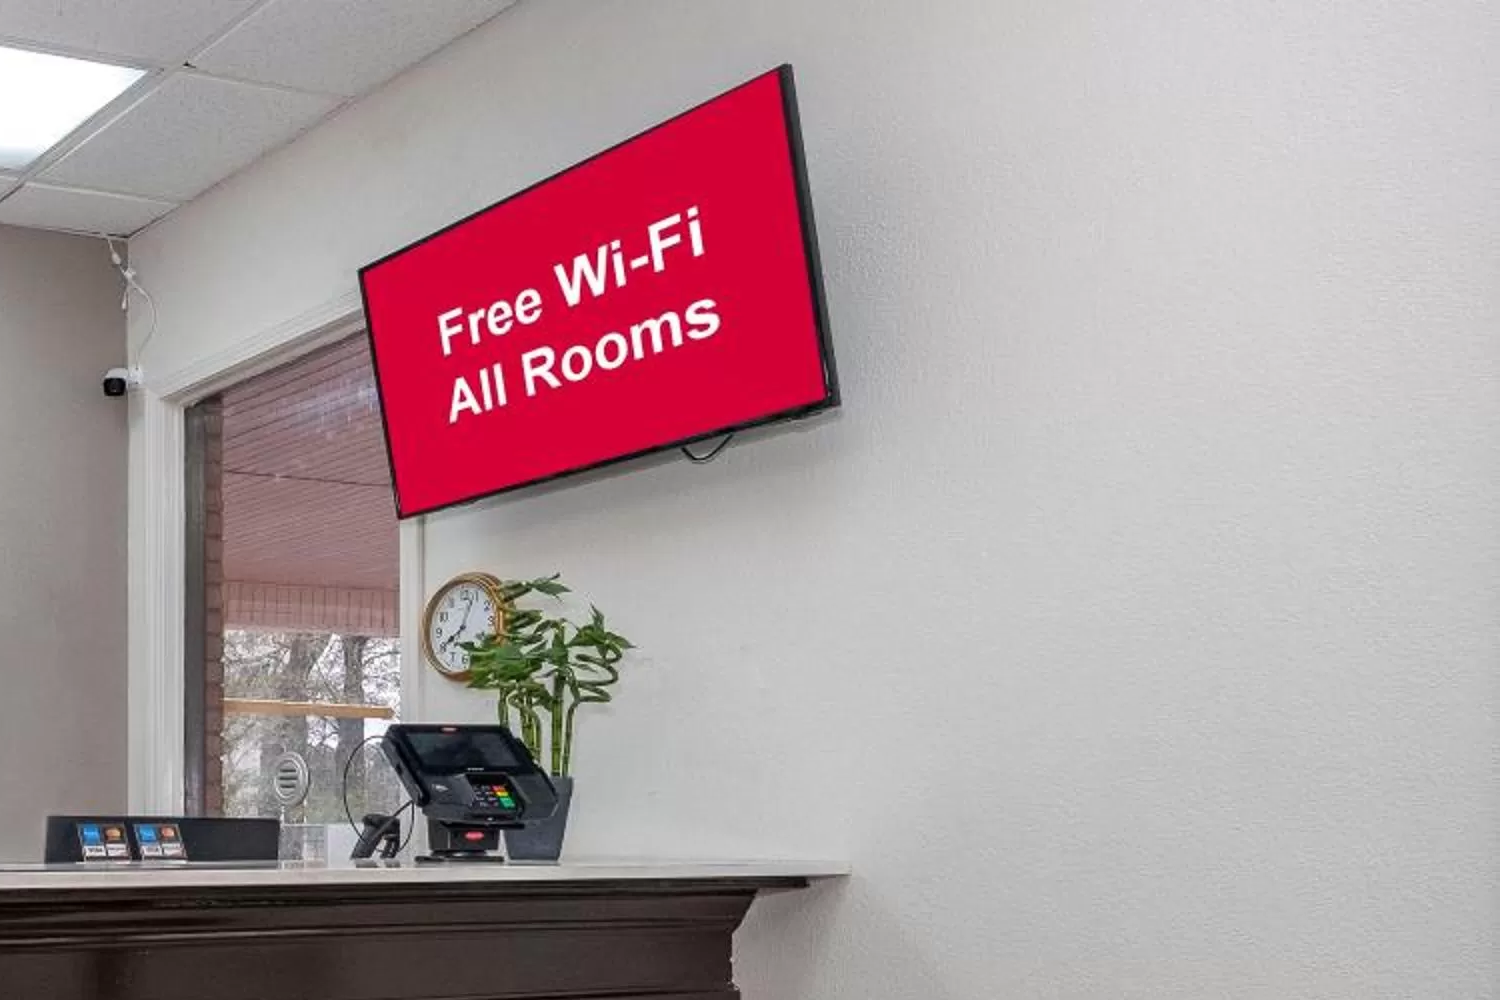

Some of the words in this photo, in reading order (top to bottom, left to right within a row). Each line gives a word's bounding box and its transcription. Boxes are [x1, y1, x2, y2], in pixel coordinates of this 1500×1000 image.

[438, 288, 543, 356] Free
[554, 206, 704, 307] Wi-Fi
[449, 363, 507, 424] All
[522, 298, 721, 397] Rooms
